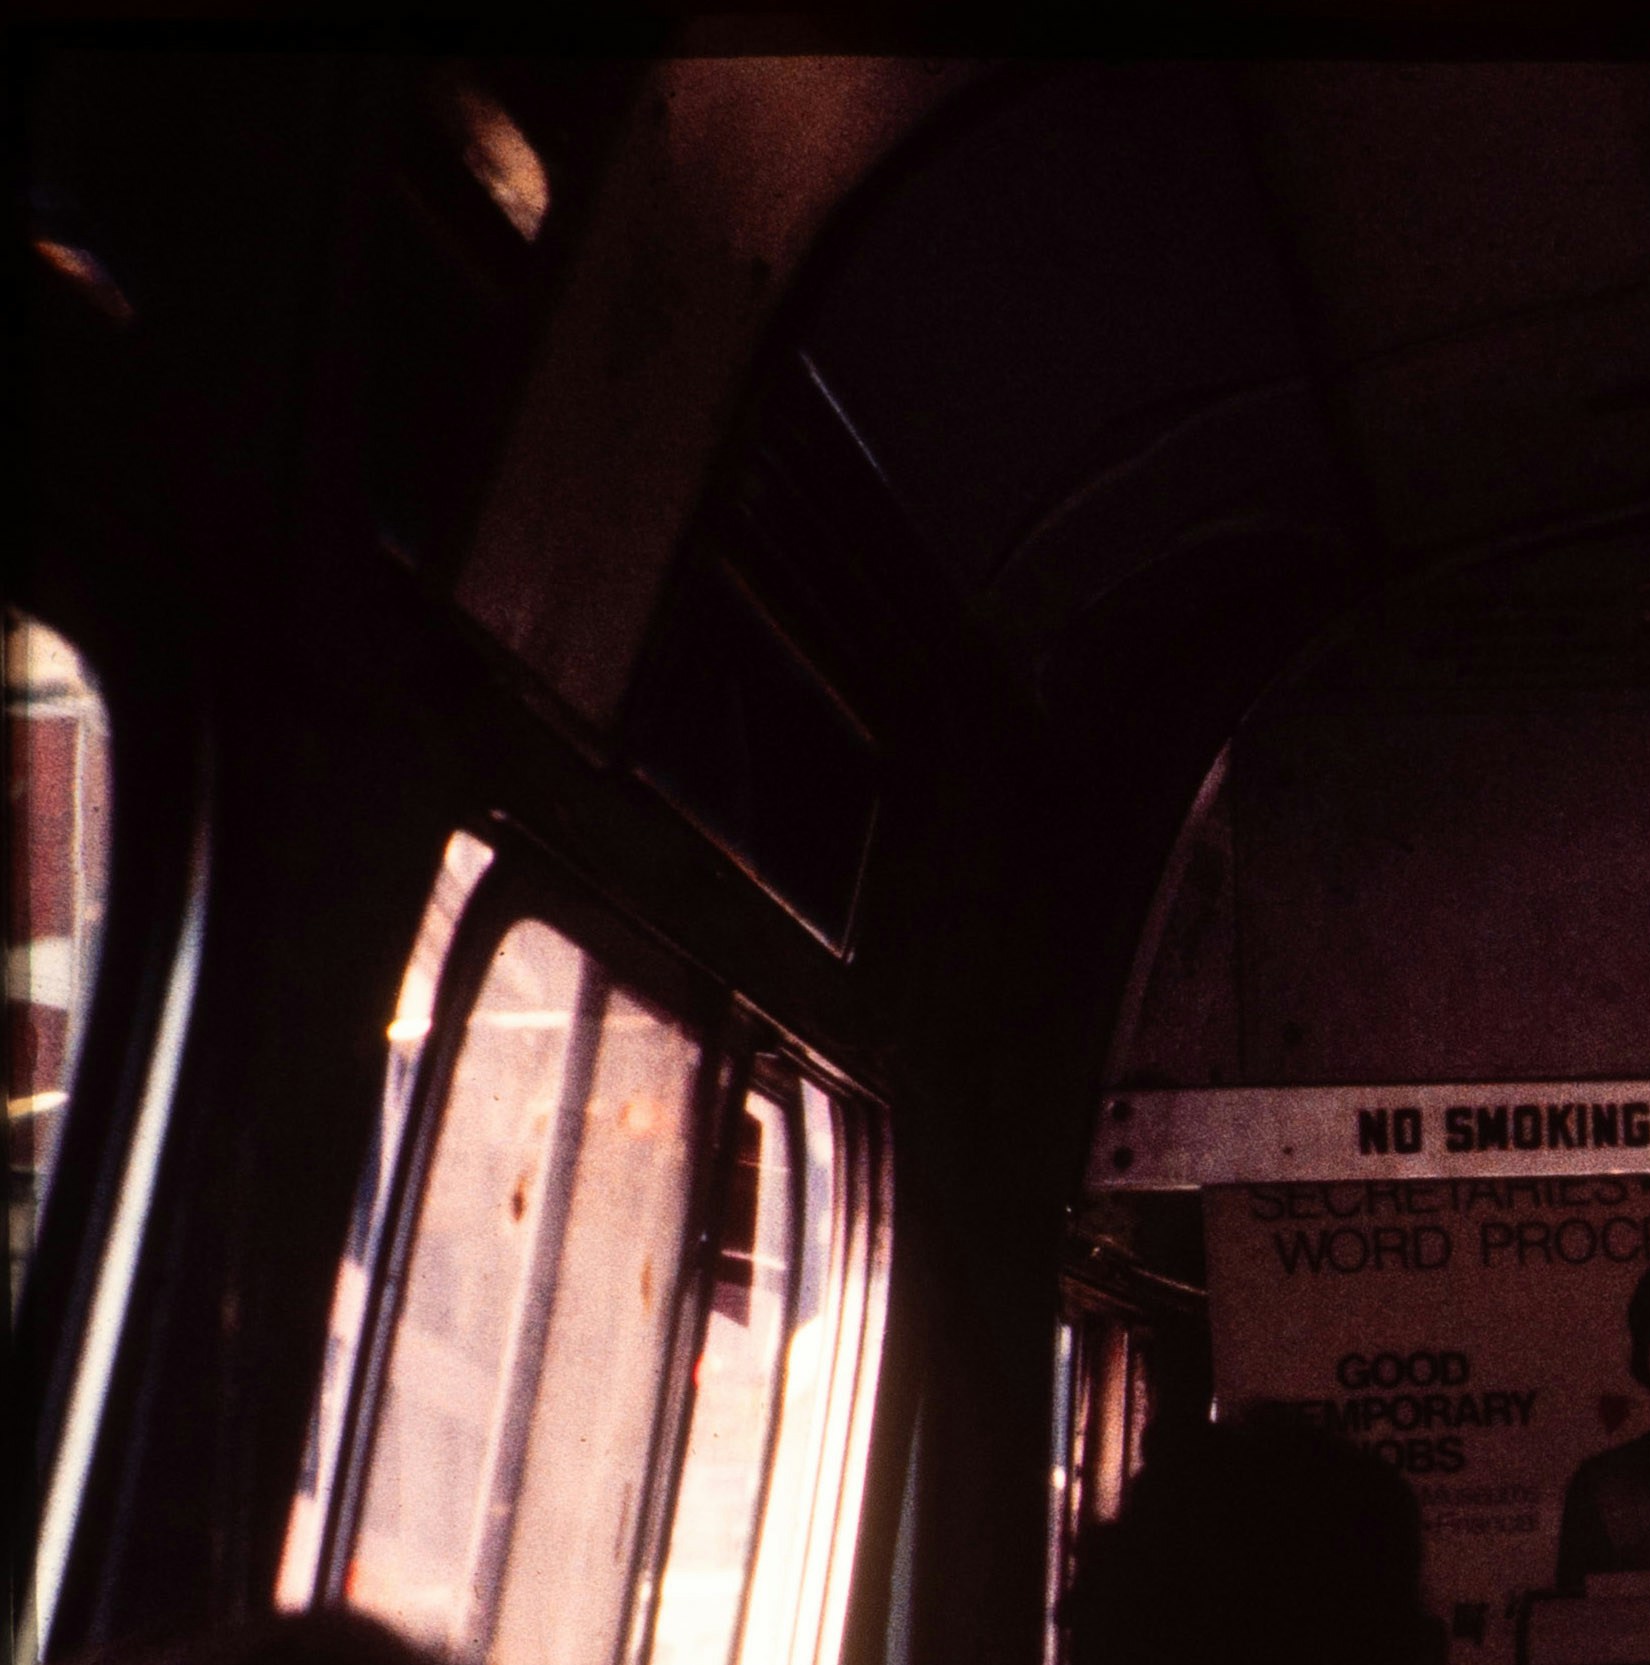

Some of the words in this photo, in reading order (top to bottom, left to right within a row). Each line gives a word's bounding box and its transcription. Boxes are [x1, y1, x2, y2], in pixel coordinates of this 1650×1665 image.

[1358, 1107, 1422, 1155] NO
[1275, 1226, 1452, 1274] WORD
[1337, 1351, 1469, 1391] GOOD
